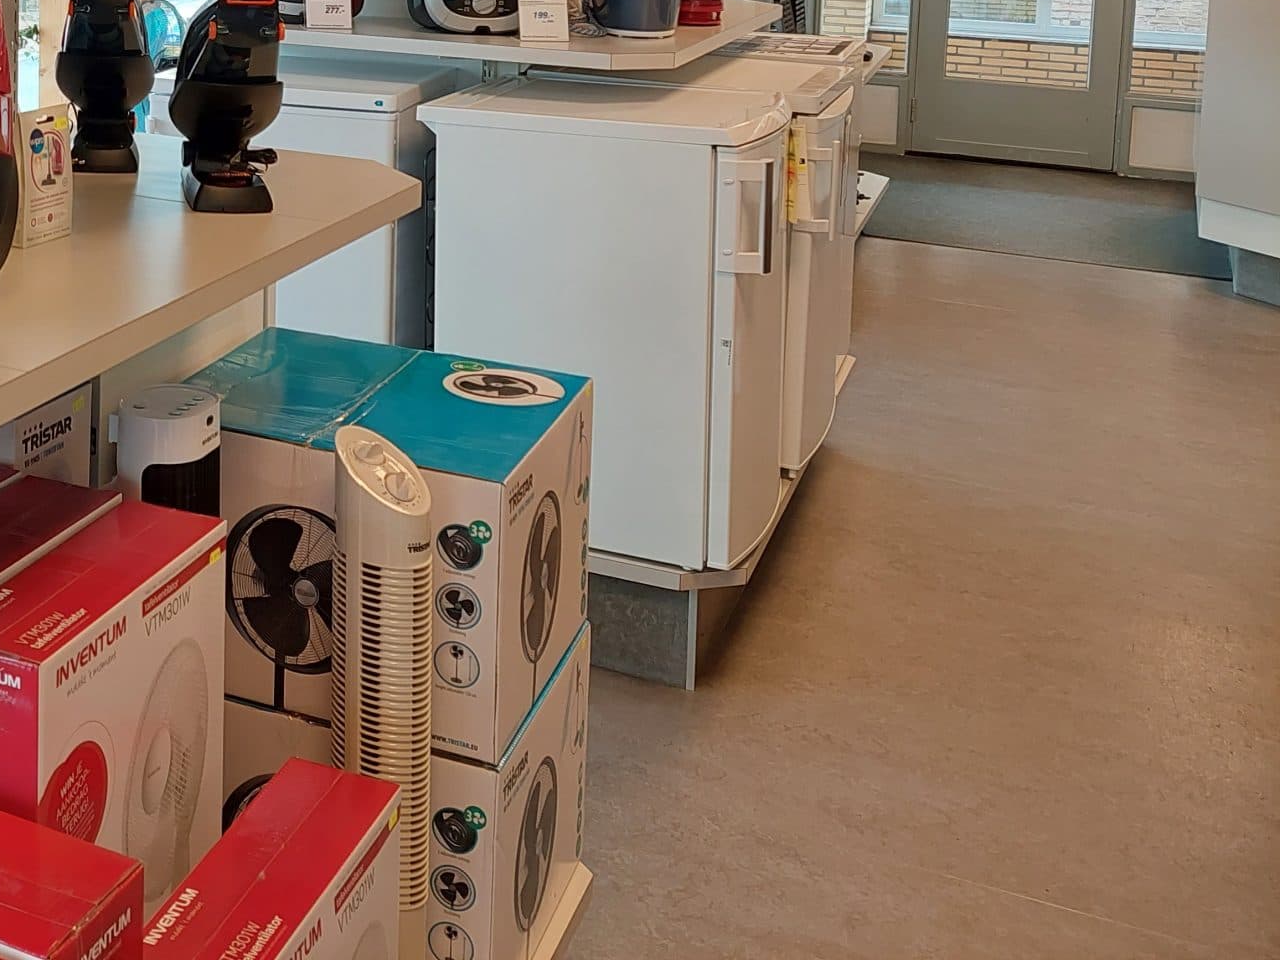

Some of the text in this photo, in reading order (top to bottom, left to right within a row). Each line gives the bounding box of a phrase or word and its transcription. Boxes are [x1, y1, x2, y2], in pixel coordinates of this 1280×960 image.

[22, 416, 72, 455] TRISTAR
[145, 585, 191, 637] VTM301W
[56, 615, 128, 689] INVENTUM
[143, 888, 200, 946] INVENTUM
